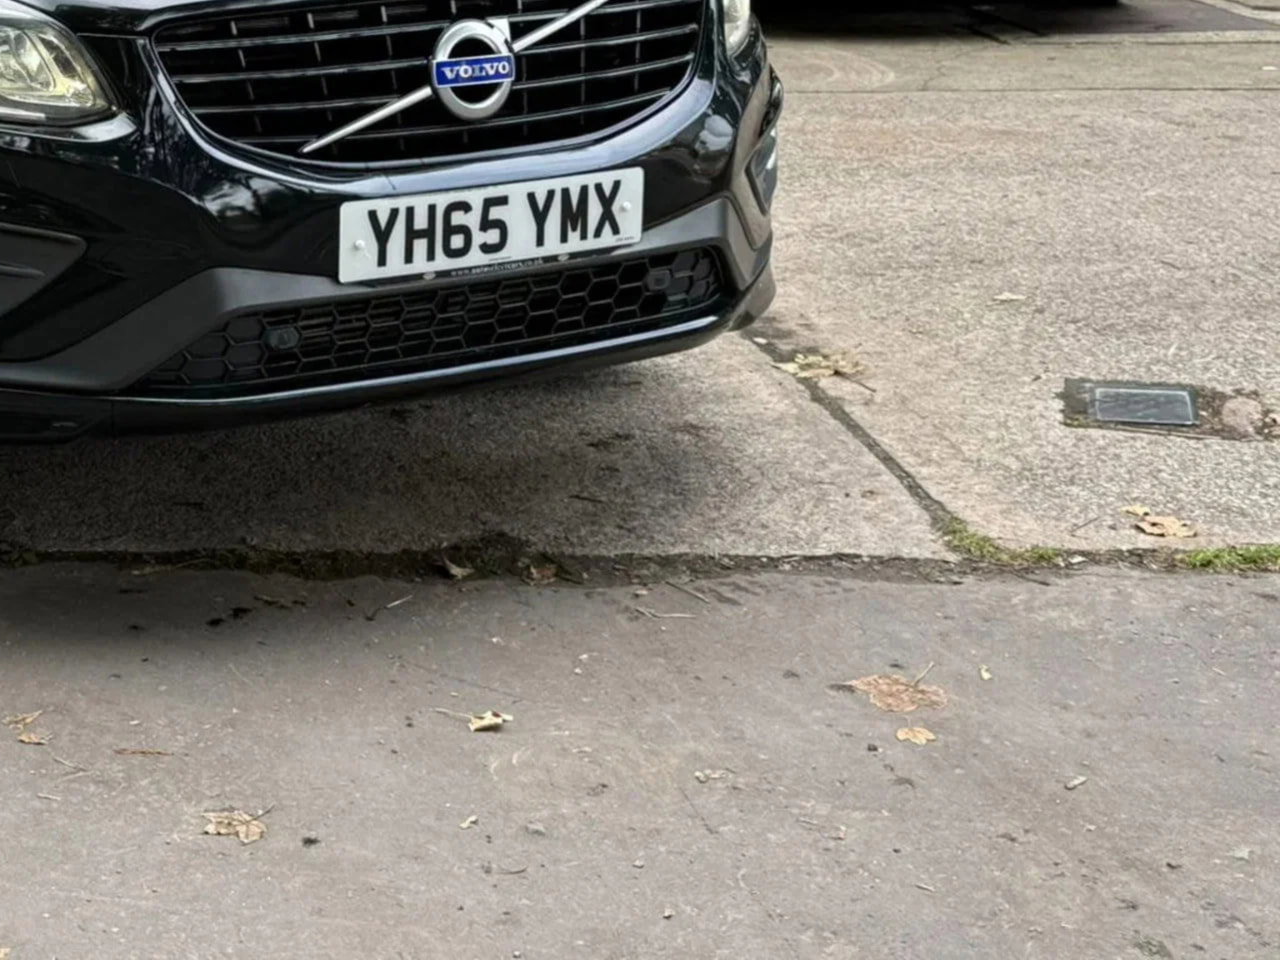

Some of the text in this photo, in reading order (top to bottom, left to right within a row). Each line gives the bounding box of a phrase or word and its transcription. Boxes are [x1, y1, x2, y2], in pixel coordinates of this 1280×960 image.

[441, 61, 510, 80] VOLVO
[367, 179, 622, 268] YH65 YMX
